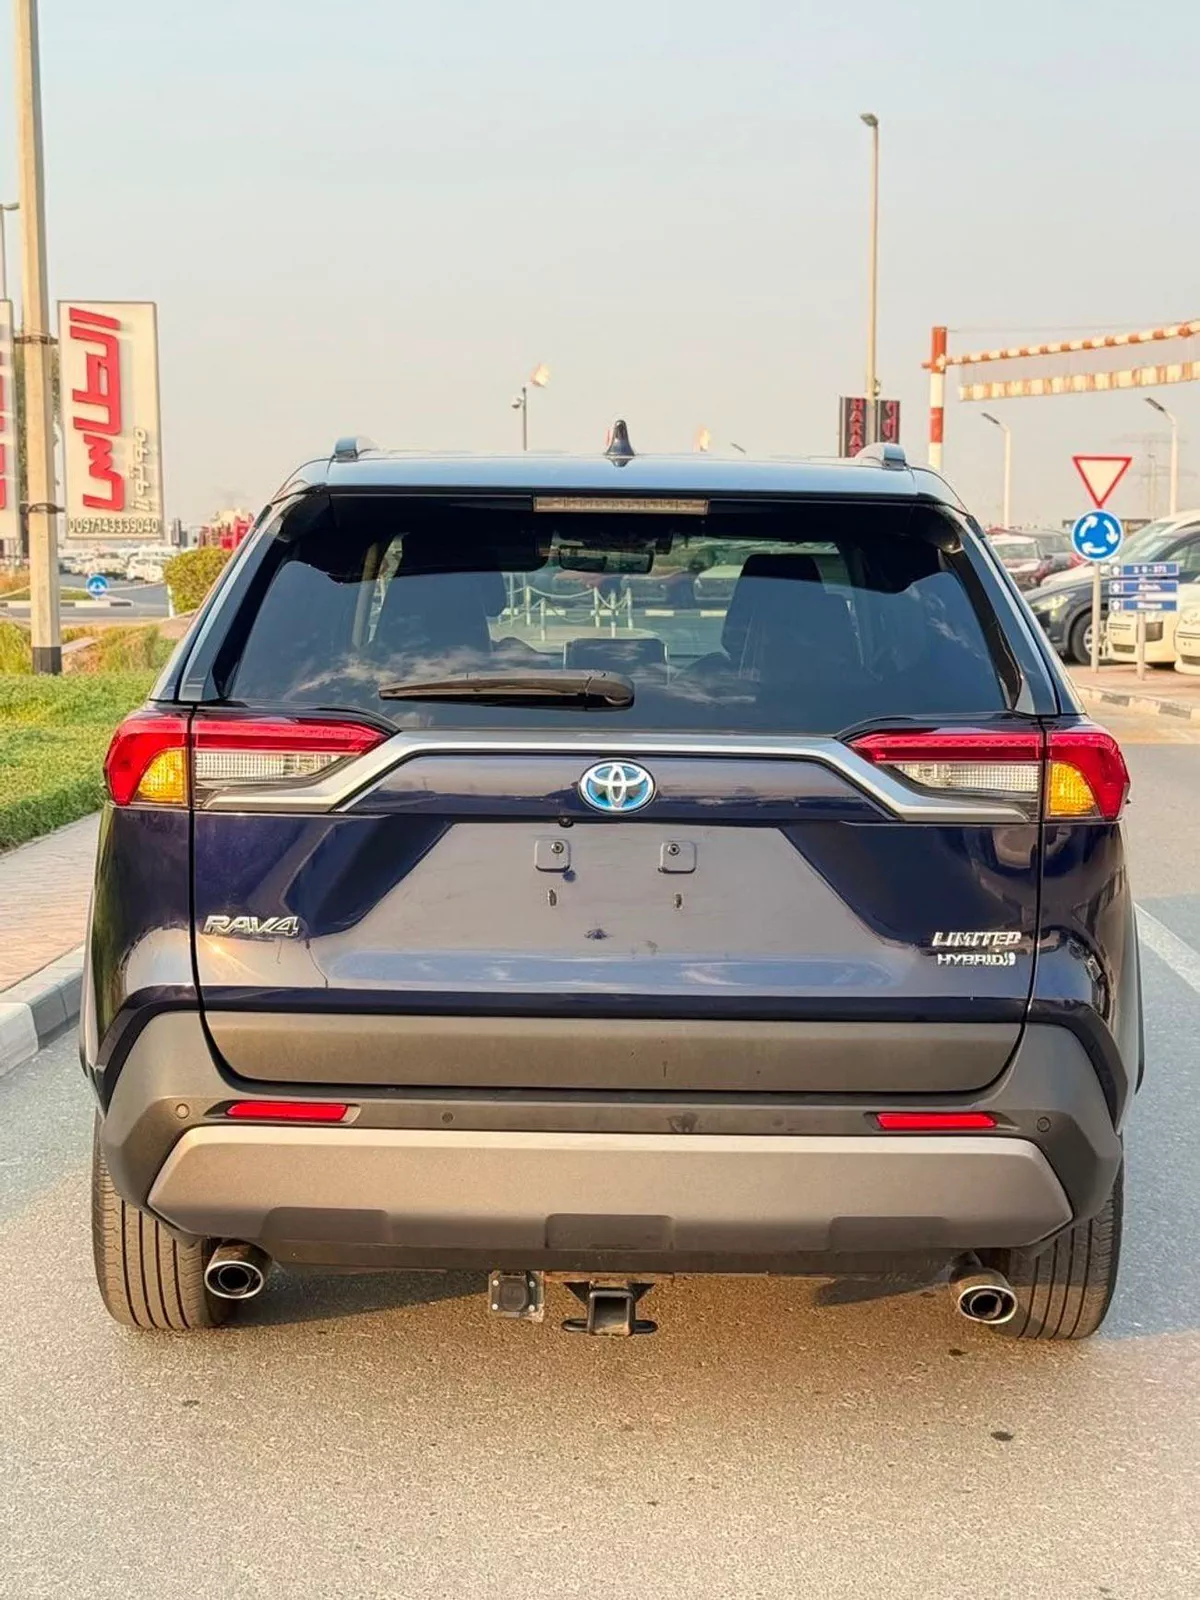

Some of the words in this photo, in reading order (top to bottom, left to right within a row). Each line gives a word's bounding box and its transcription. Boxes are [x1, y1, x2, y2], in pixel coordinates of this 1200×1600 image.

[68, 517, 159, 533] 0097143339040
[203, 915, 300, 936] RAV4
[932, 931, 1022, 947] LIMITED
[937, 953, 1005, 966] HYBRID
